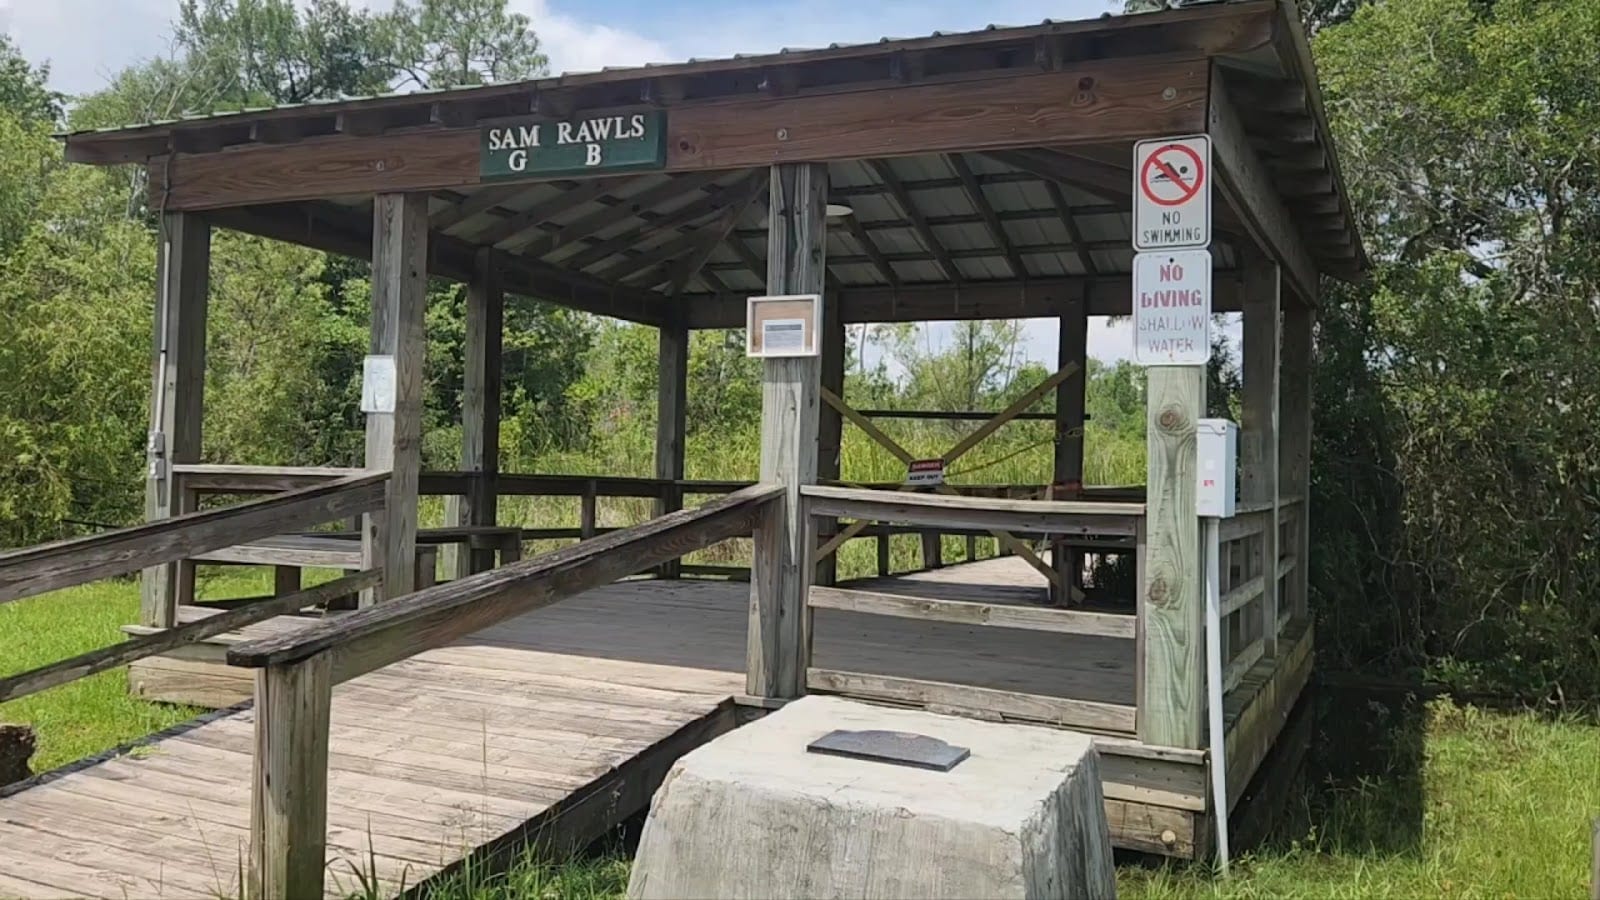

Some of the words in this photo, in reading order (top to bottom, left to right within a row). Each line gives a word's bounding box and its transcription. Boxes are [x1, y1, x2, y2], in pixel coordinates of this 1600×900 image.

[489, 125, 540, 150] SAM
[557, 115, 645, 144] RAWLS
[508, 150, 528, 171] G
[585, 144, 602, 166] B
[1162, 211, 1181, 225] NO
[1143, 227, 1201, 243] SWIMMING
[1160, 264, 1183, 282] NO
[1141, 289, 1202, 308] DIVING
[1148, 337, 1193, 353] WATER
